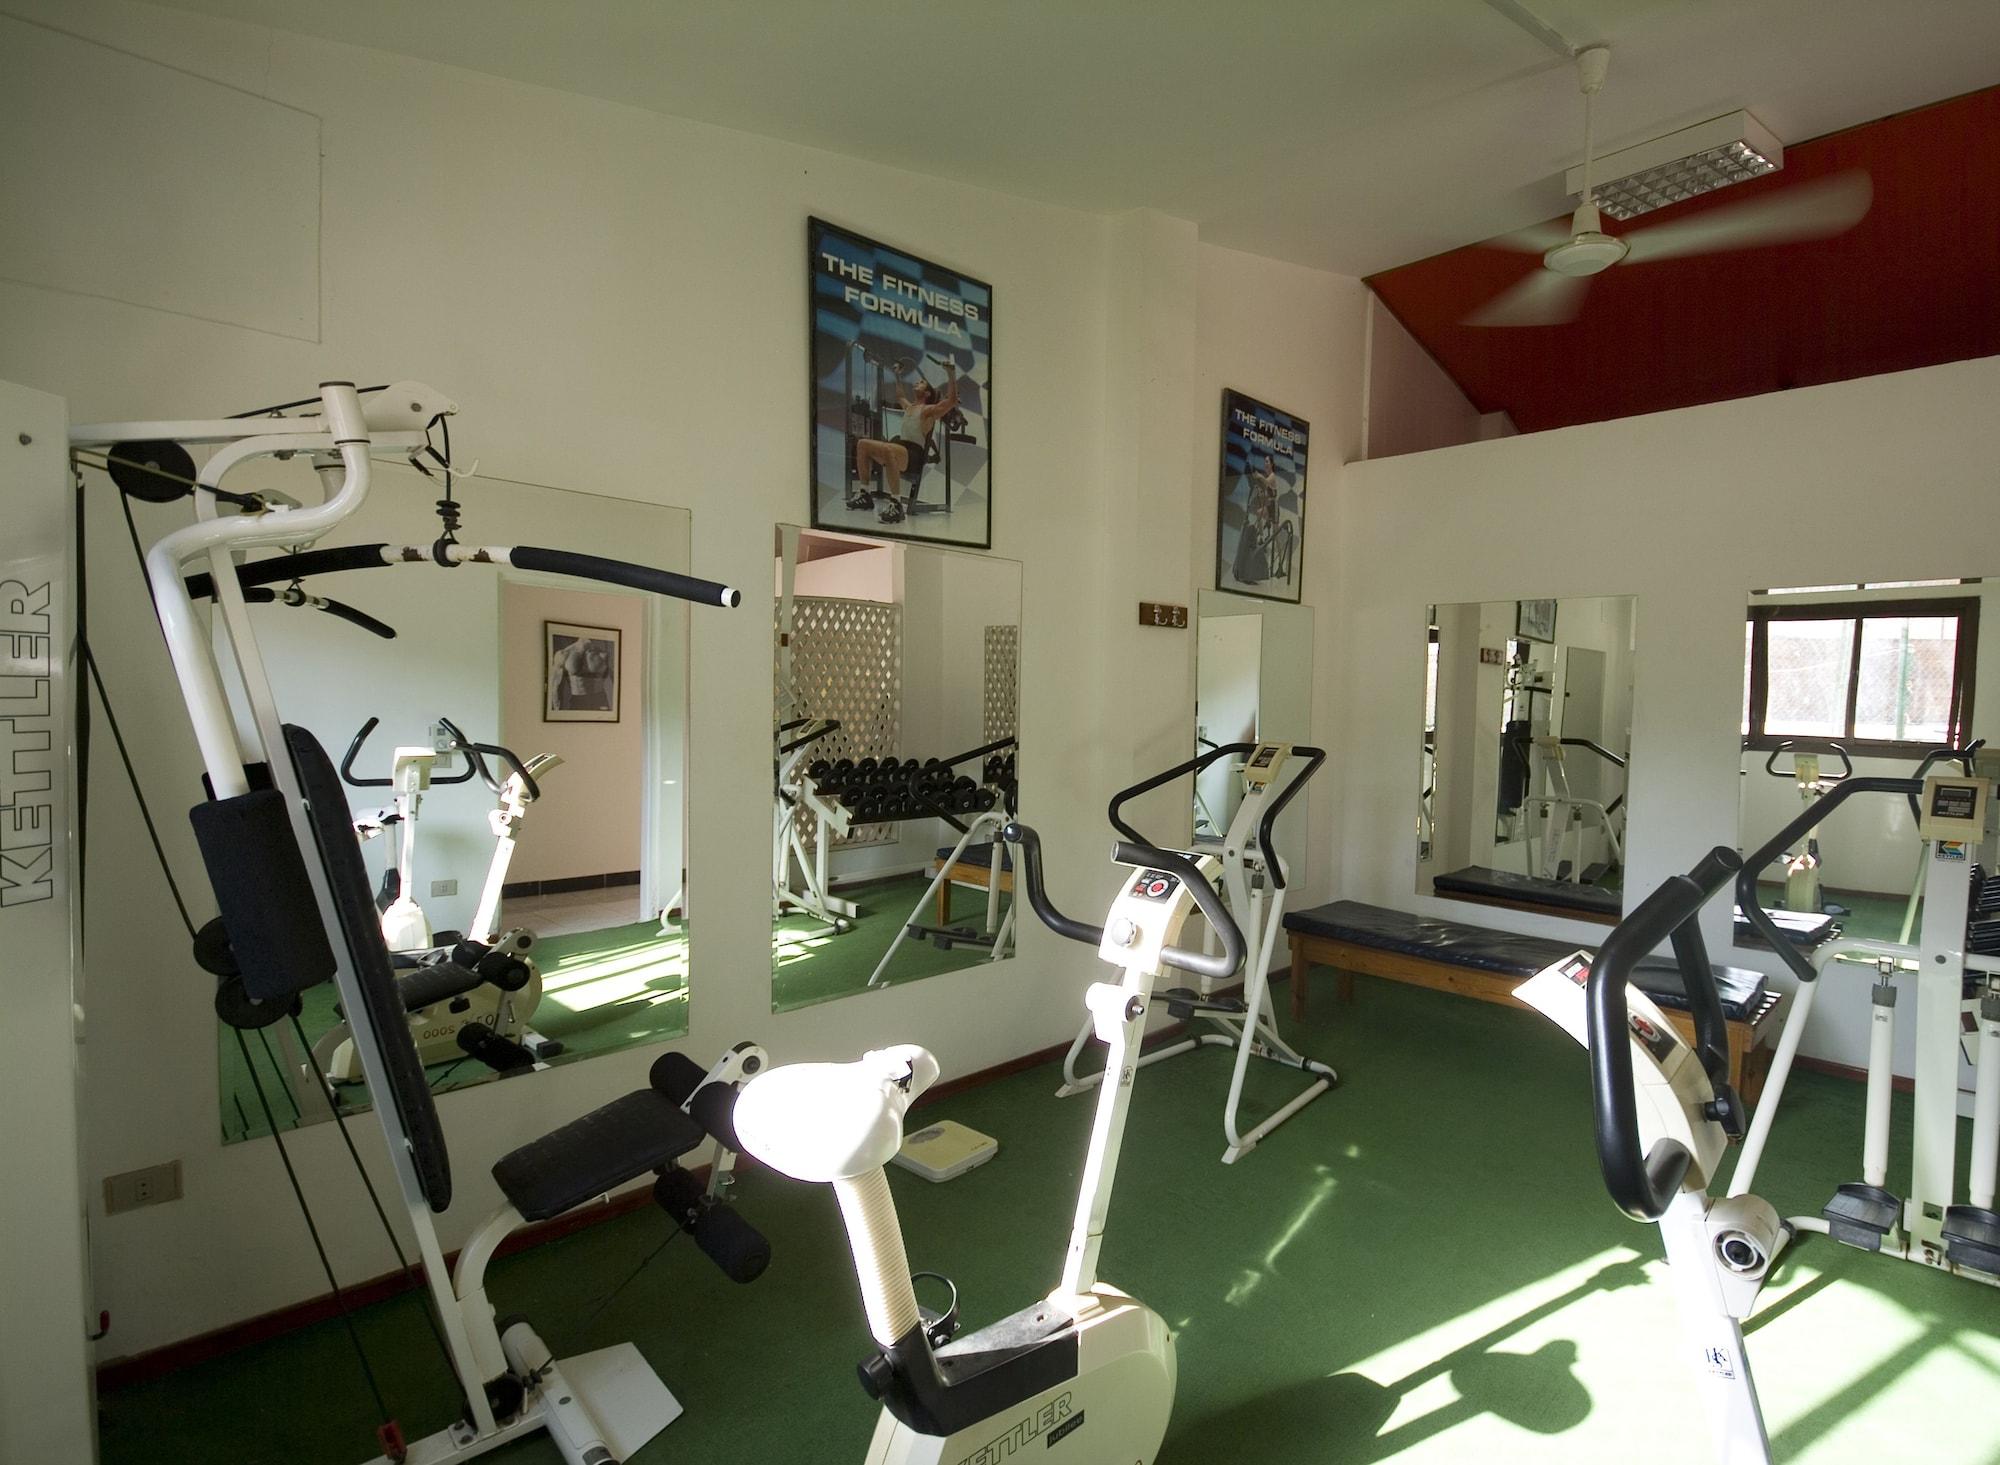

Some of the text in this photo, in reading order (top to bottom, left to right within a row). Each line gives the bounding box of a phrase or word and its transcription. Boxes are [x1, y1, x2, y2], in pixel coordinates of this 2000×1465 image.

[822, 252, 979, 321] THE FITNESS
[844, 286, 962, 339] FORMULA
[1235, 408, 1302, 445] THE FITNESS
[1243, 428, 1293, 456] FORMULA
[0, 579, 53, 908] KETTLER
[957, 1391, 1073, 1465] ETTLER
